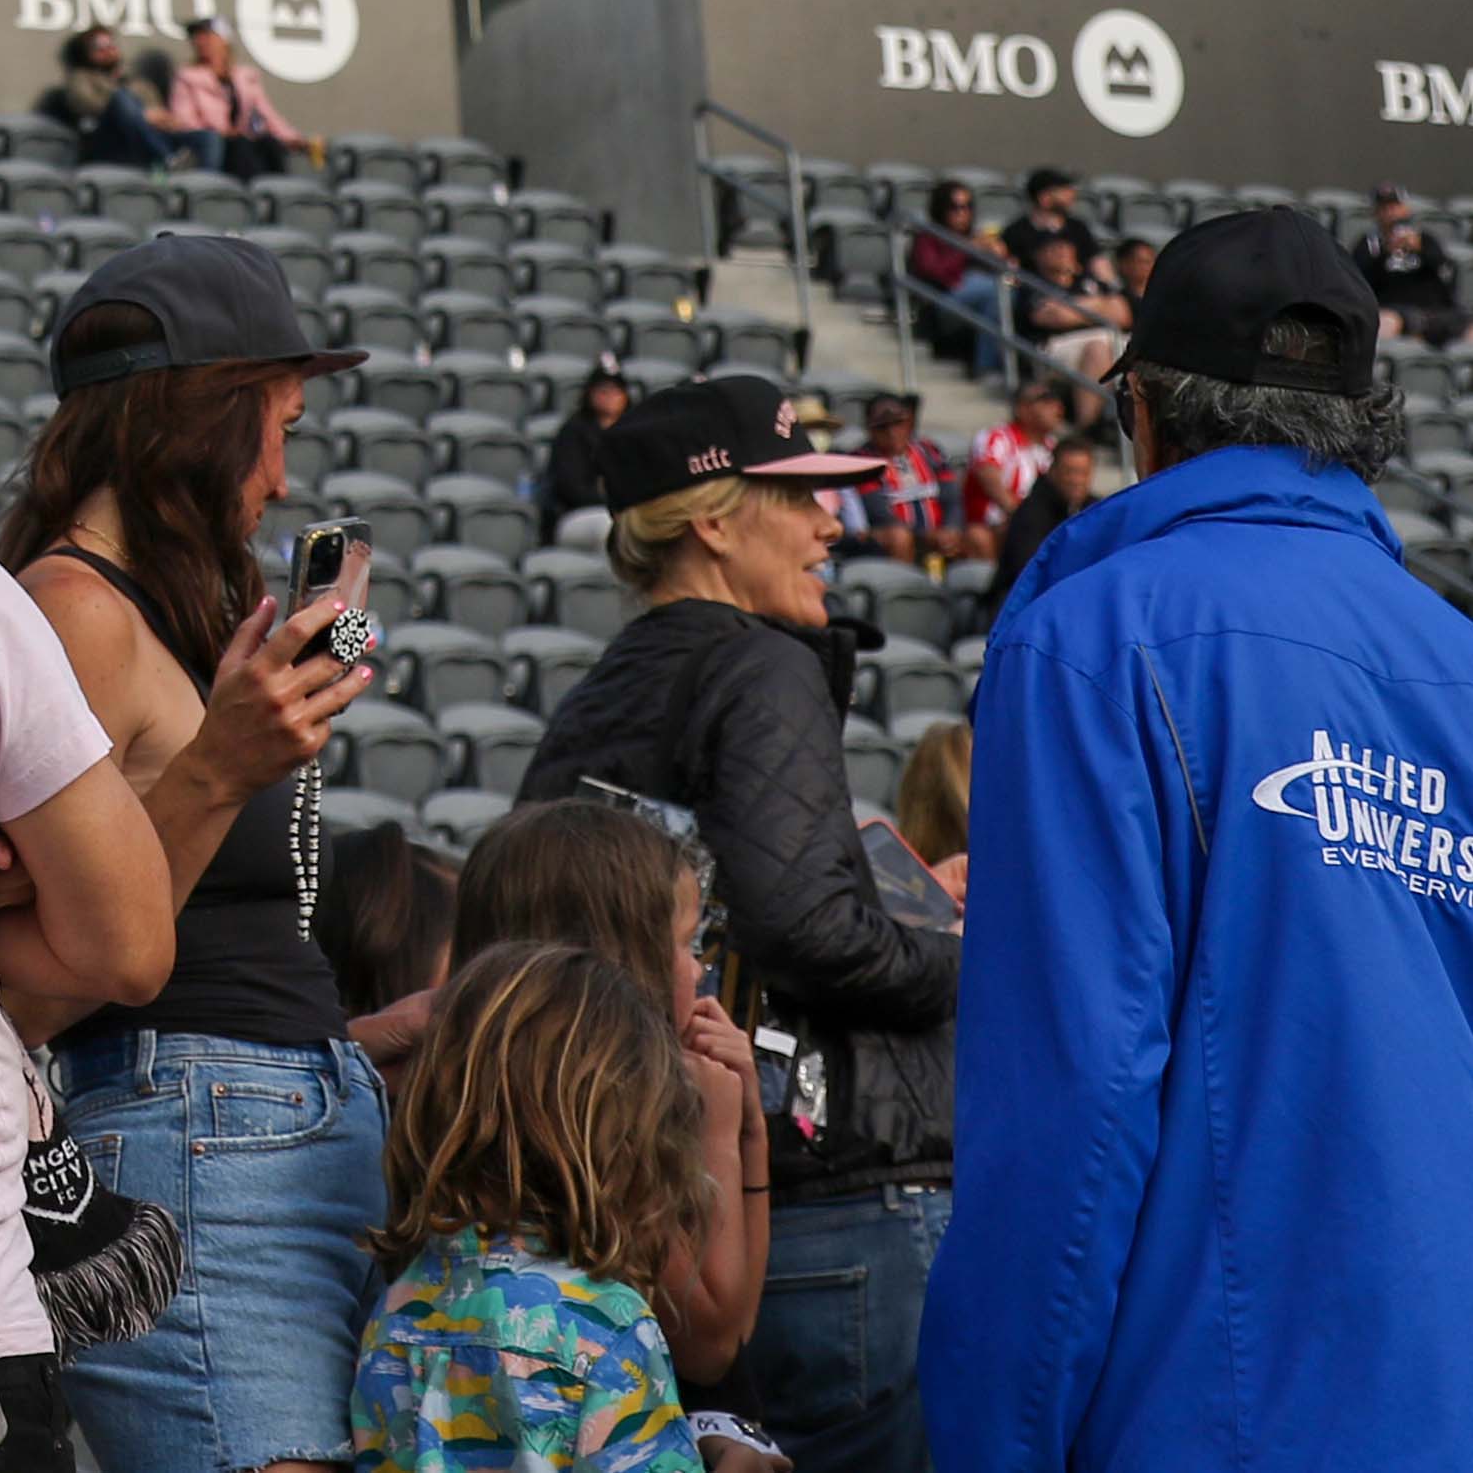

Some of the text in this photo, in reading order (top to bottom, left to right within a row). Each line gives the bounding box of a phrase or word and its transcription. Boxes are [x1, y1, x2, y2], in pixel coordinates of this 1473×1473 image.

[875, 25, 1058, 99] BMO
[1312, 730, 1446, 815] ALLIED
[1322, 846, 1400, 874] EVEN
[22, 1135, 79, 1177] NGEL
[33, 1158, 82, 1195] CITY
[57, 1186, 77, 1206] FC
